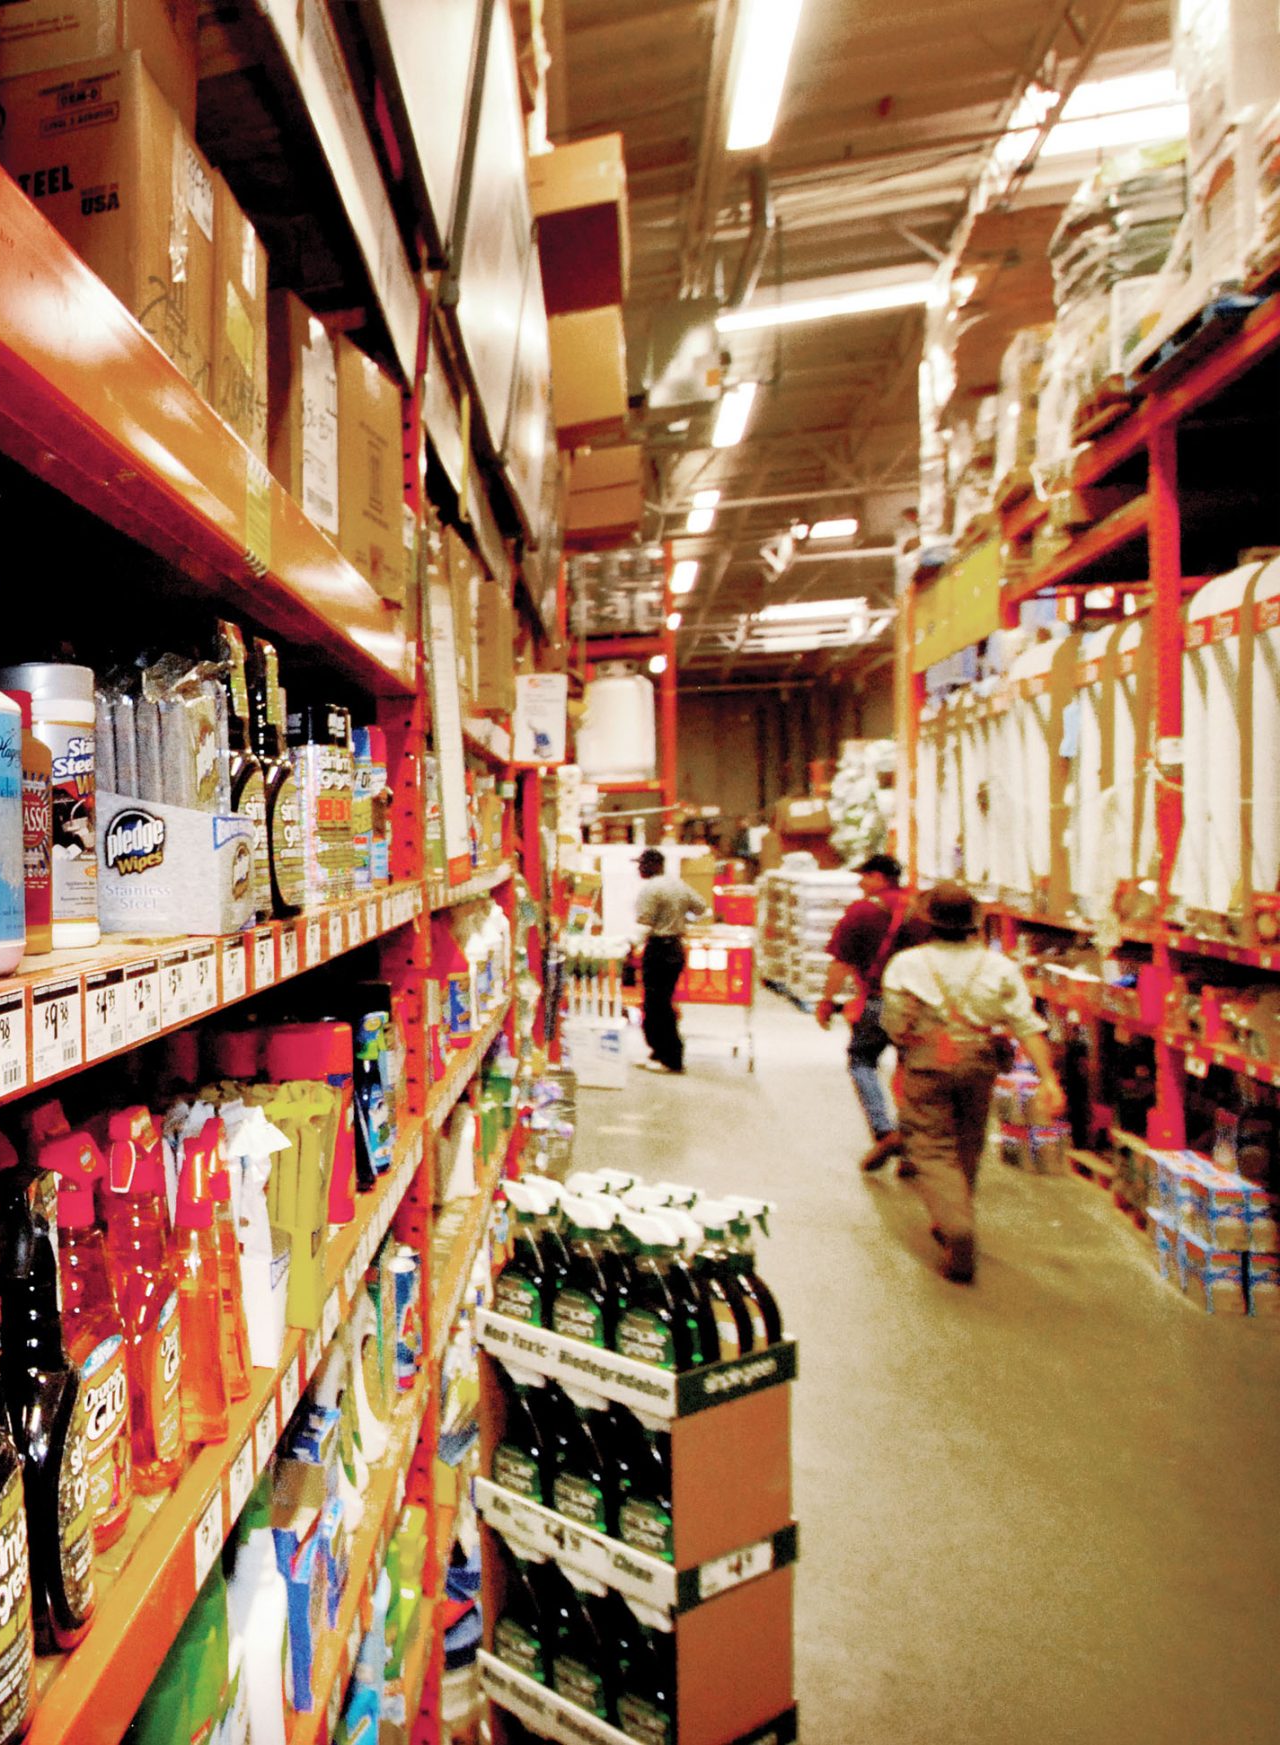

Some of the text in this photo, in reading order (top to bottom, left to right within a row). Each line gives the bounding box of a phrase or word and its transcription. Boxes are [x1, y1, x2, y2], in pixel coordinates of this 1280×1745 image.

[81, 192, 120, 216] USA
[106, 817, 165, 867] pledge
[117, 849, 164, 877] Wipes
[104, 883, 171, 898] Stainless
[120, 897, 158, 911] Steel
[0, 1017, 11, 1040] 98
